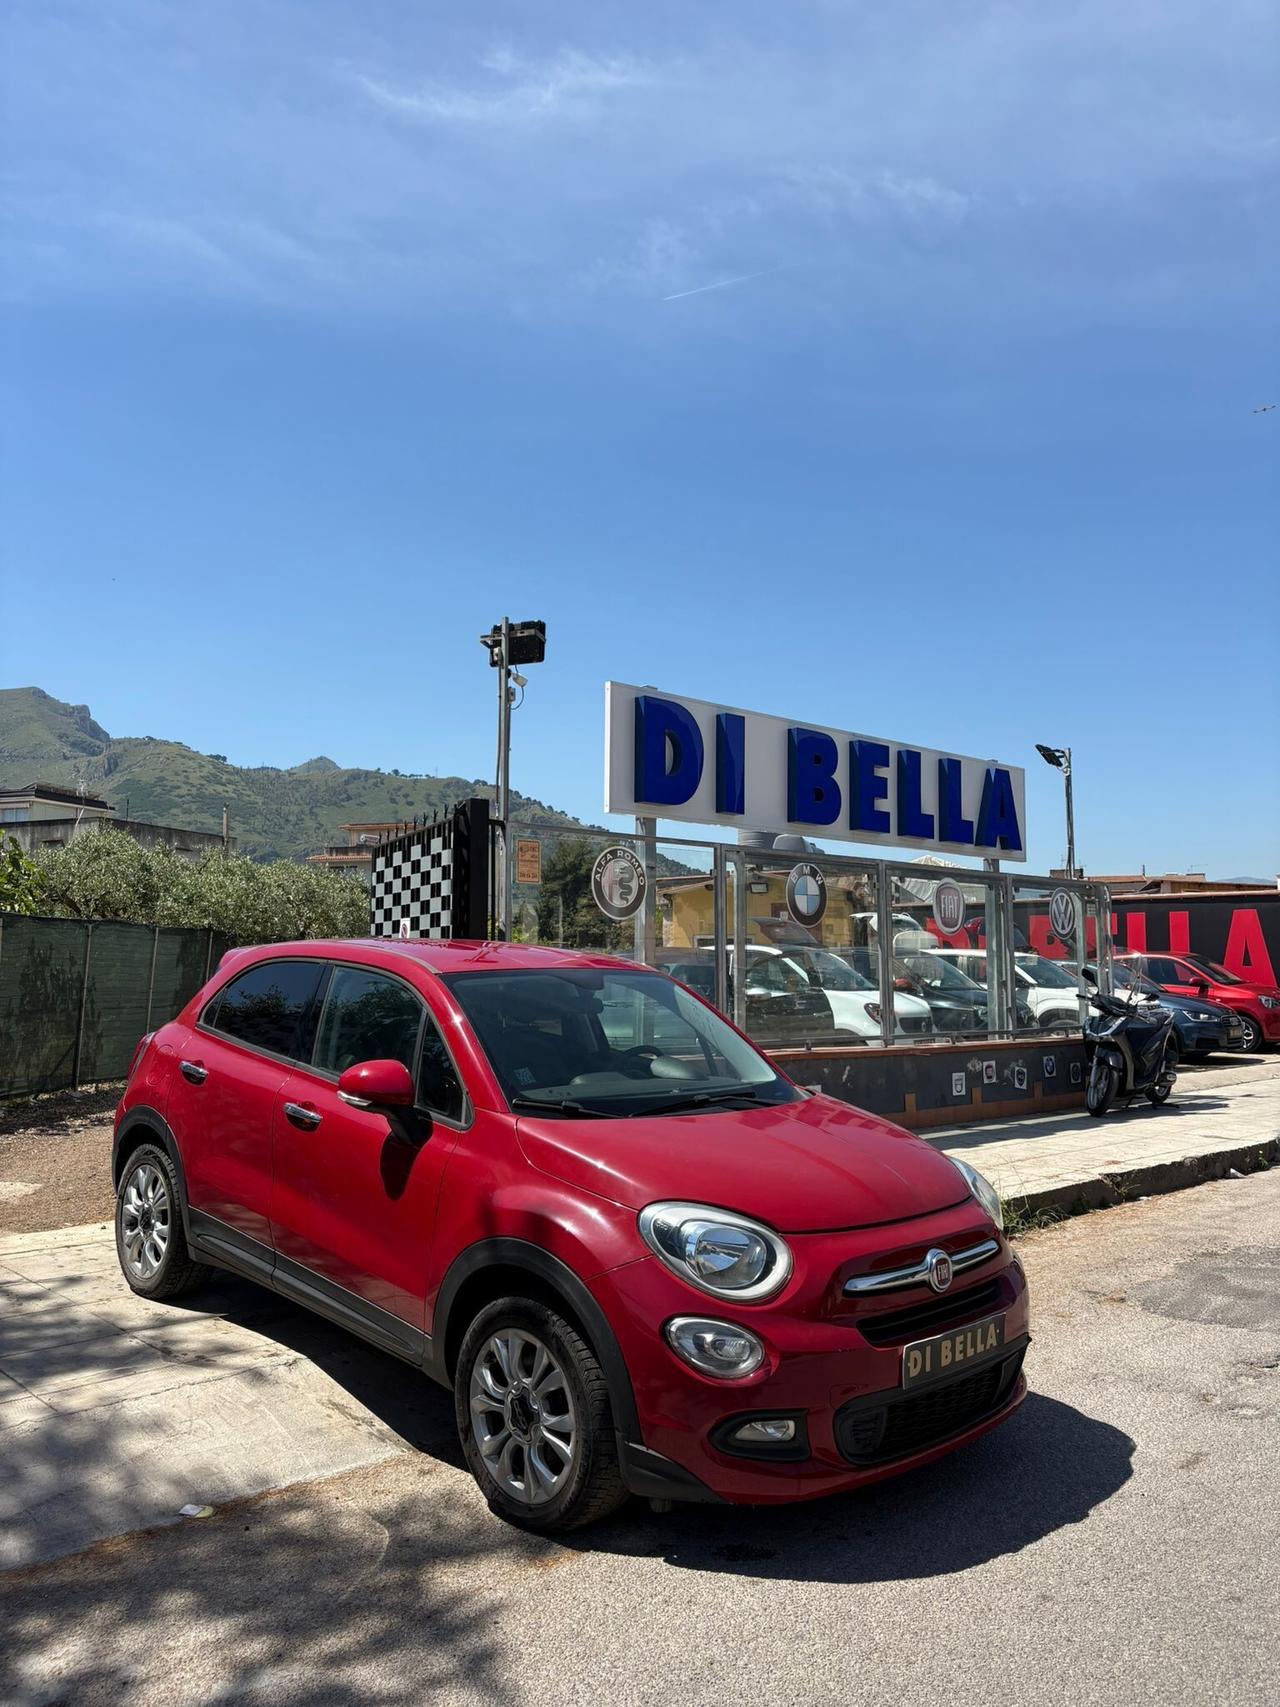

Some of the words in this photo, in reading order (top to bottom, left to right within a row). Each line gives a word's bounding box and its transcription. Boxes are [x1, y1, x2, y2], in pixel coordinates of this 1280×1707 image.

[634, 694, 745, 815] DI
[787, 726, 1022, 851] BELLA
[595, 853, 613, 881] ALFA
[617, 850, 645, 886] ROMEO
[790, 865, 824, 884] BMW
[941, 895, 958, 919] FIAT
[909, 1345, 932, 1378] DI
[941, 1323, 997, 1368] BELLA
